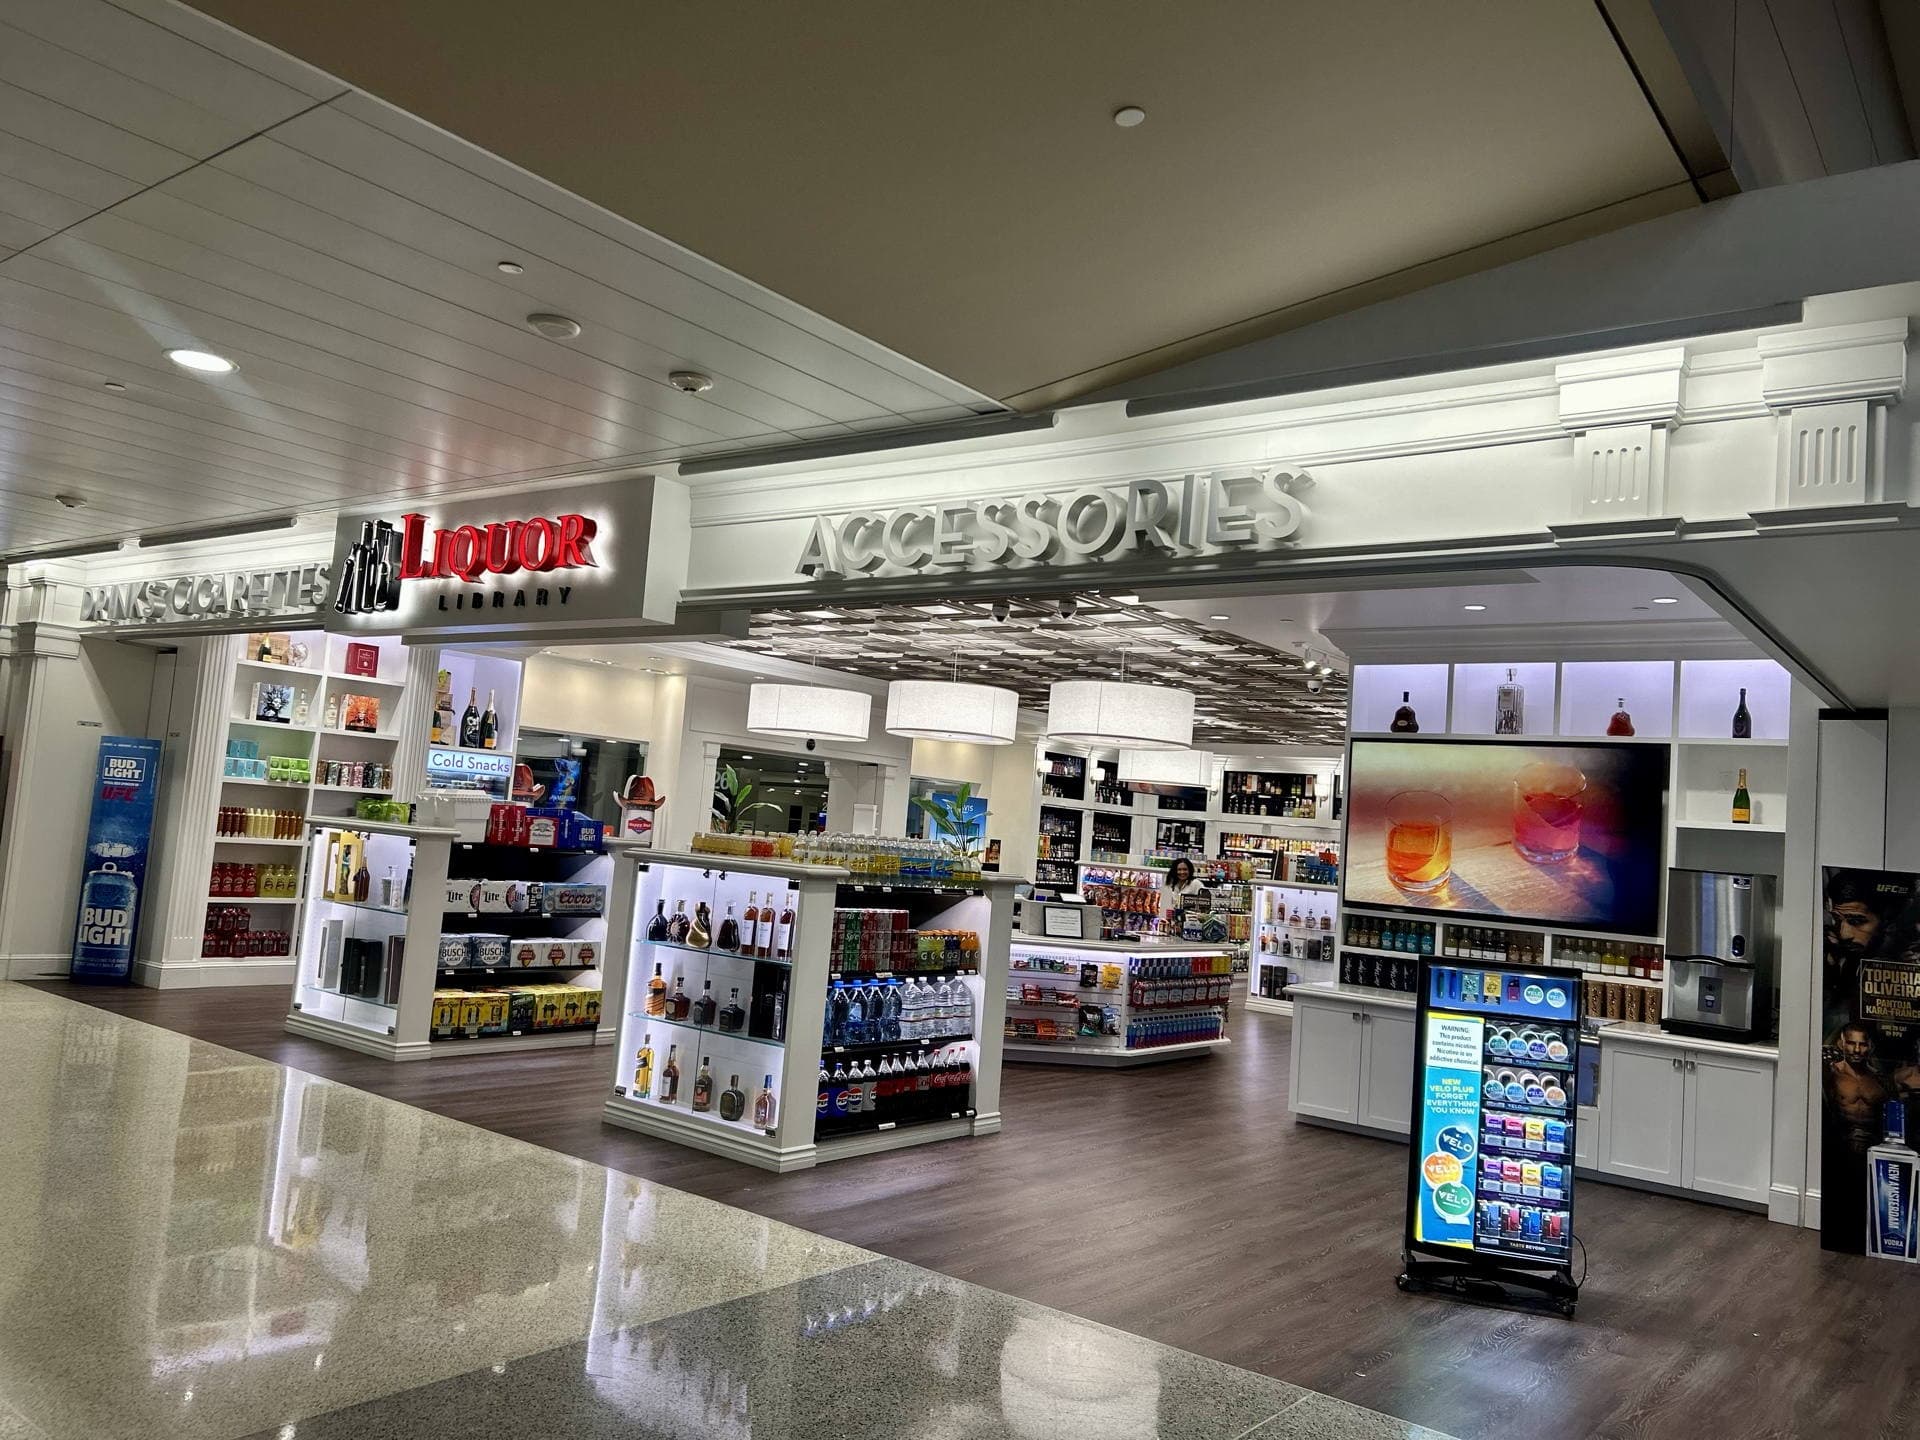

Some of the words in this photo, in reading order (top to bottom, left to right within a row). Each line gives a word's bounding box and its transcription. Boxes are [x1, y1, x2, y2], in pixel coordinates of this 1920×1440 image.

[795, 462, 1315, 578] ACCESSORIES
[397, 512, 598, 584] LIQUOR
[80, 581, 167, 621] DRINKS
[172, 562, 331, 614] CIGARETTES
[438, 587, 571, 611] LIBRARY
[109, 758, 138, 770] BUD
[432, 753, 464, 768] Cold
[467, 756, 510, 773] Snacks
[104, 766, 142, 779] LIGHT
[101, 786, 138, 801] UFC
[1876, 884, 1898, 893] UFC
[447, 890, 463, 903] Lite
[484, 890, 500, 903] Lite
[559, 889, 593, 905] Coors
[83, 907, 128, 926] BUD
[441, 946, 467, 957] BUSCH
[479, 945, 505, 957] BUSCH
[1865, 968, 1920, 986] TOPURIA
[1864, 981, 1920, 998] OLIVEIRA
[1876, 998, 1912, 1009] PANTOJA
[1441, 1025, 1470, 1034] WARNING:
[1451, 1034, 1472, 1042] product
[1435, 1092, 1469, 1100] FORGET
[1426, 1100, 1478, 1108] EVERYTHING
[1442, 1133, 1472, 1153] VELO
[1426, 1164, 1458, 1174] VELO
[1888, 1164, 1899, 1183] NEW
[1438, 1190, 1469, 1206] VELO
[1888, 1183, 1899, 1229] AMSTERDAM
[1883, 1238, 1904, 1248] VODKA
